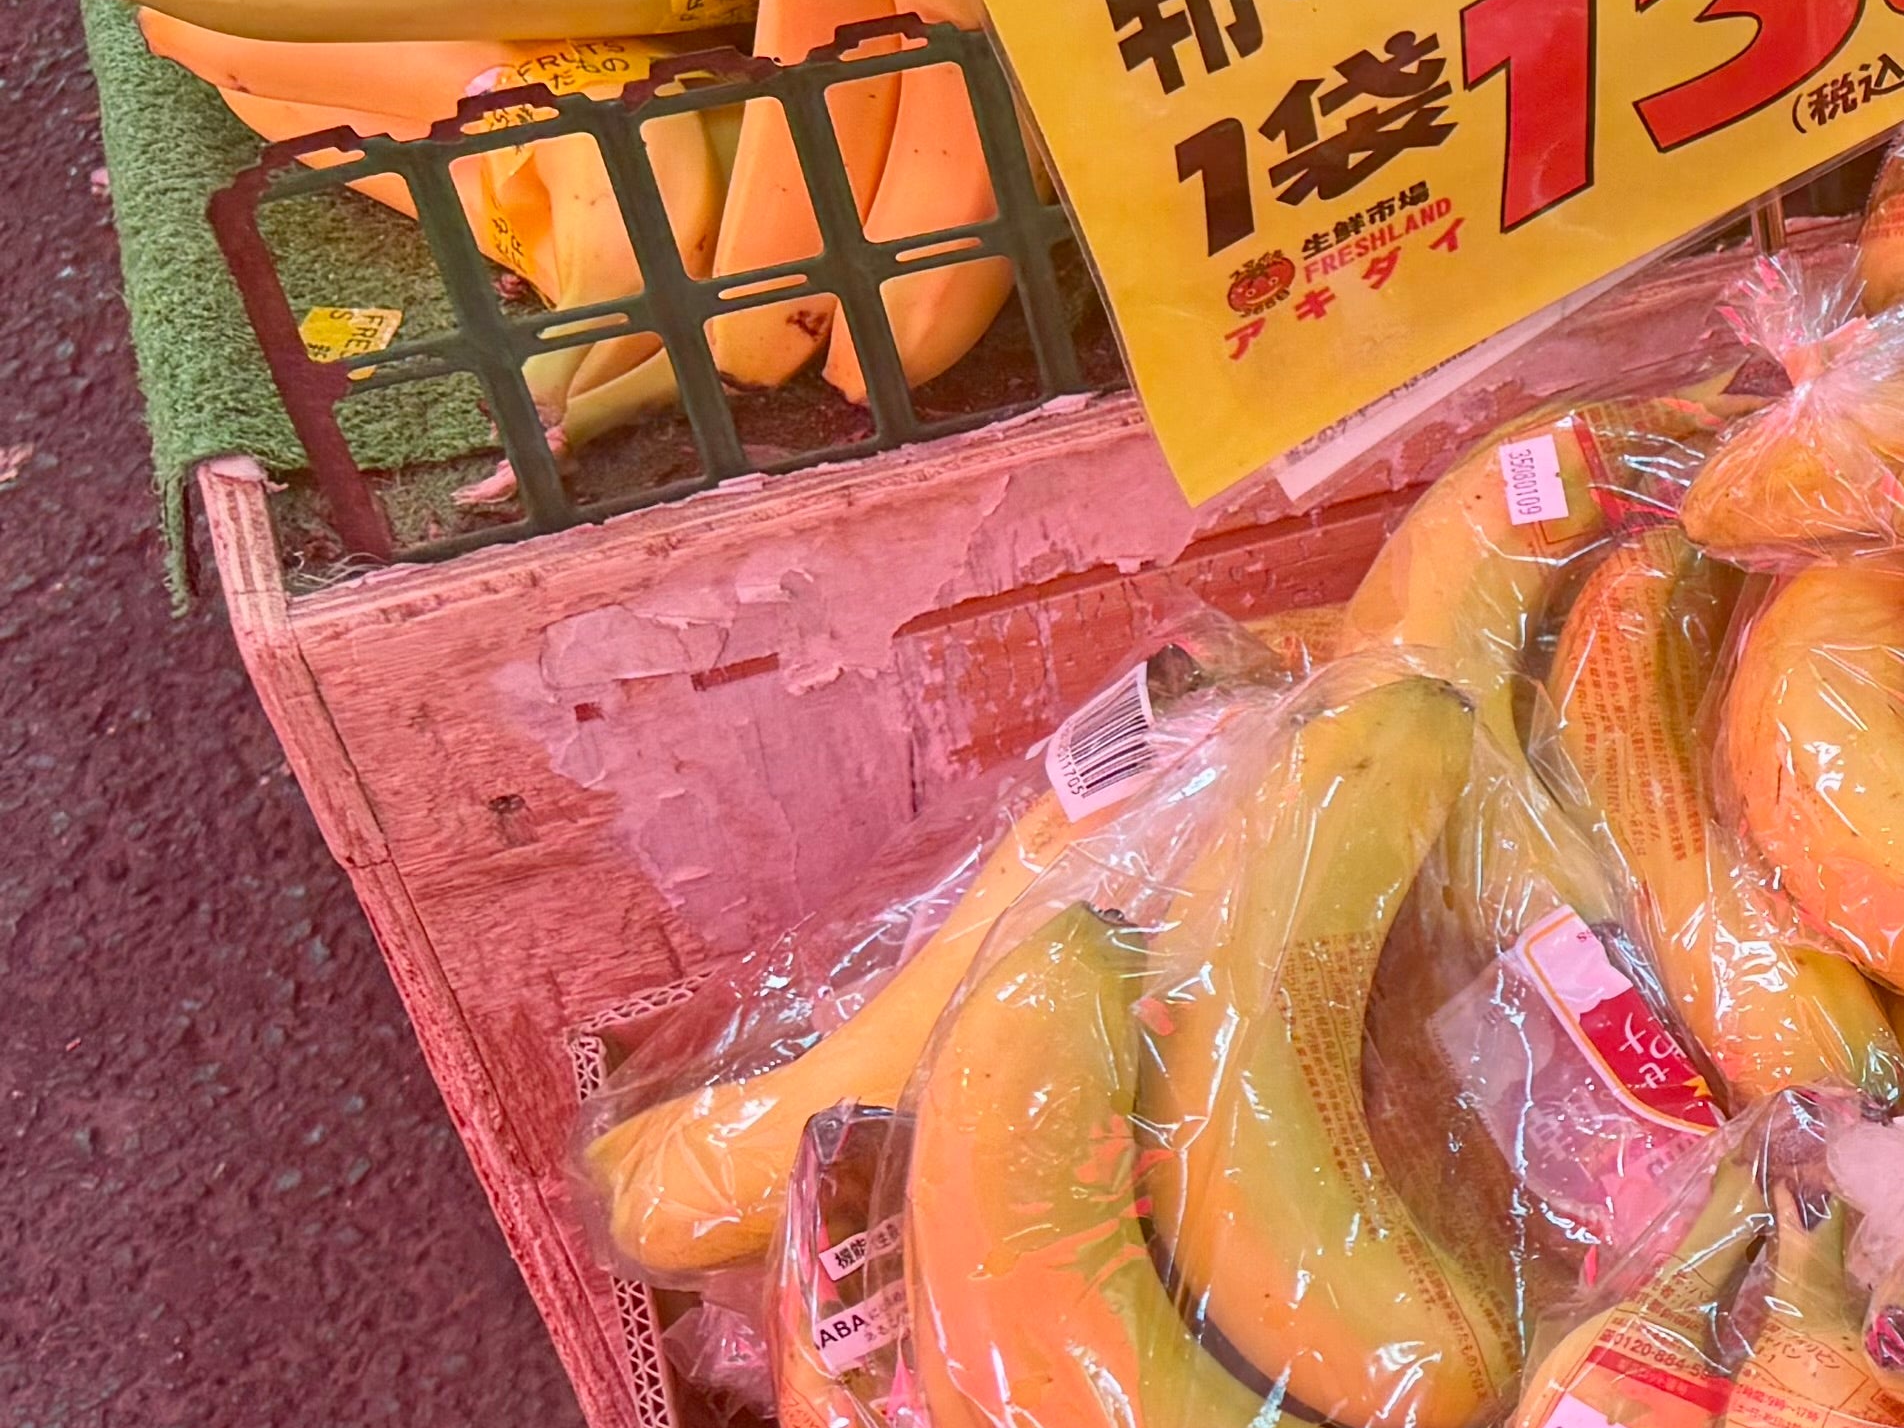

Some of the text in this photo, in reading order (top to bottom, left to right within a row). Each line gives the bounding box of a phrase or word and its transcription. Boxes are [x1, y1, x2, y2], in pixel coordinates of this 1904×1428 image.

[1174, 29, 1458, 257] 1袋
[1302, 179, 1431, 261] 生鮮市場
[1304, 196, 1453, 285] FRESHLAND
[1225, 217, 1467, 362] アキダイ
[1511, 446, 1538, 517] 35080109
